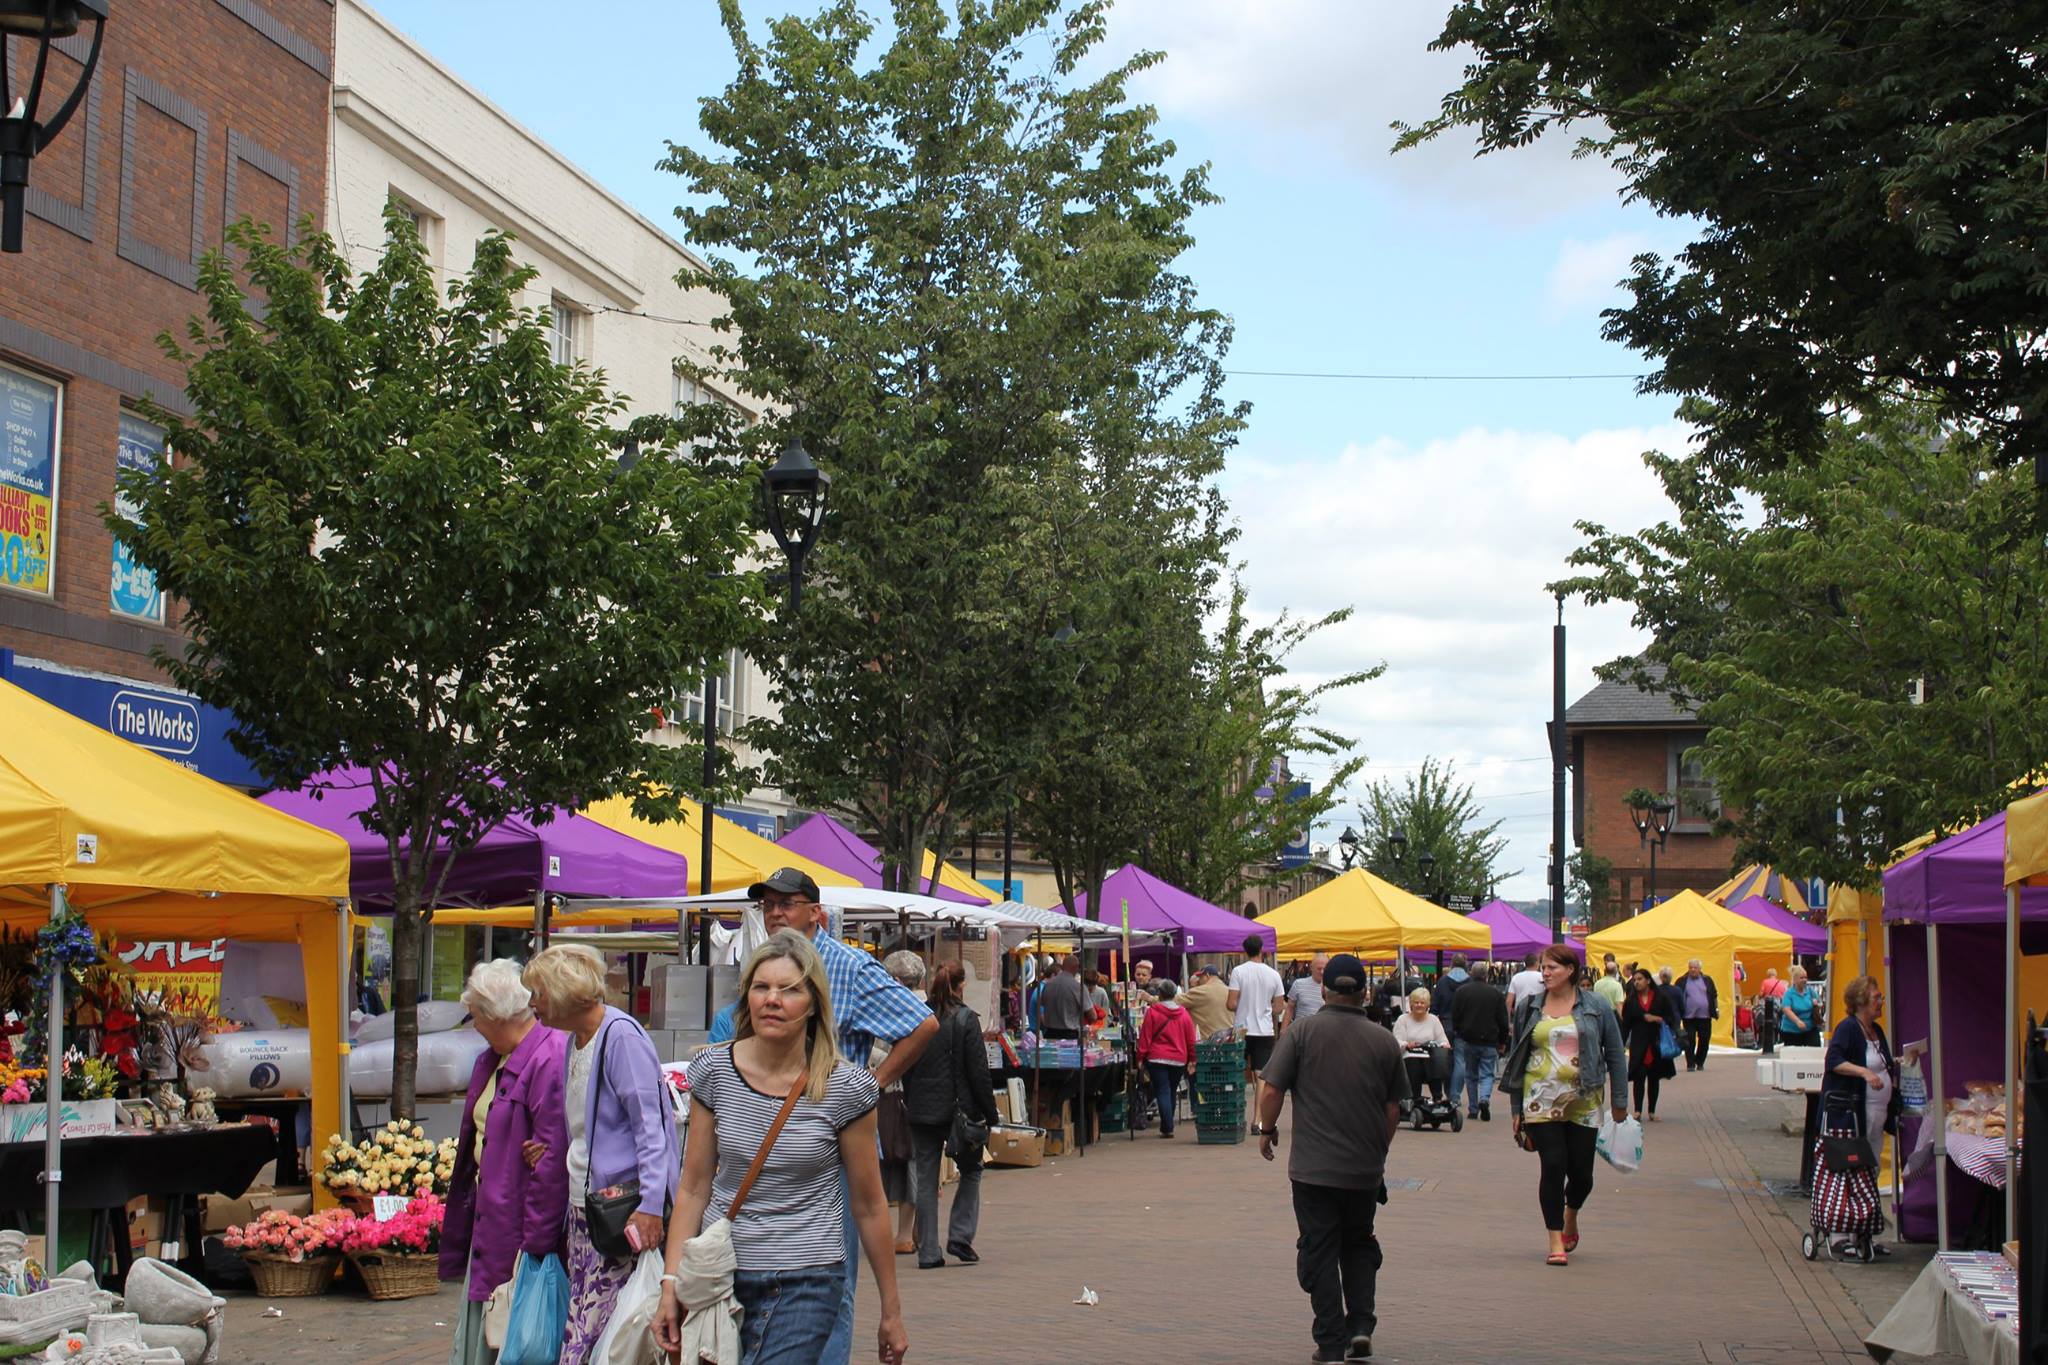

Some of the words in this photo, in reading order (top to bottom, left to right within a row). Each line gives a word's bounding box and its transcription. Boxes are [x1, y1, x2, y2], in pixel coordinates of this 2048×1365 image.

[118, 702, 145, 735] The
[148, 707, 194, 743] Works
[118, 938, 226, 969] SALE
[240, 1046, 269, 1054] BOUNCE
[270, 1045, 288, 1053] BACK
[249, 1053, 281, 1061] PILLOWS
